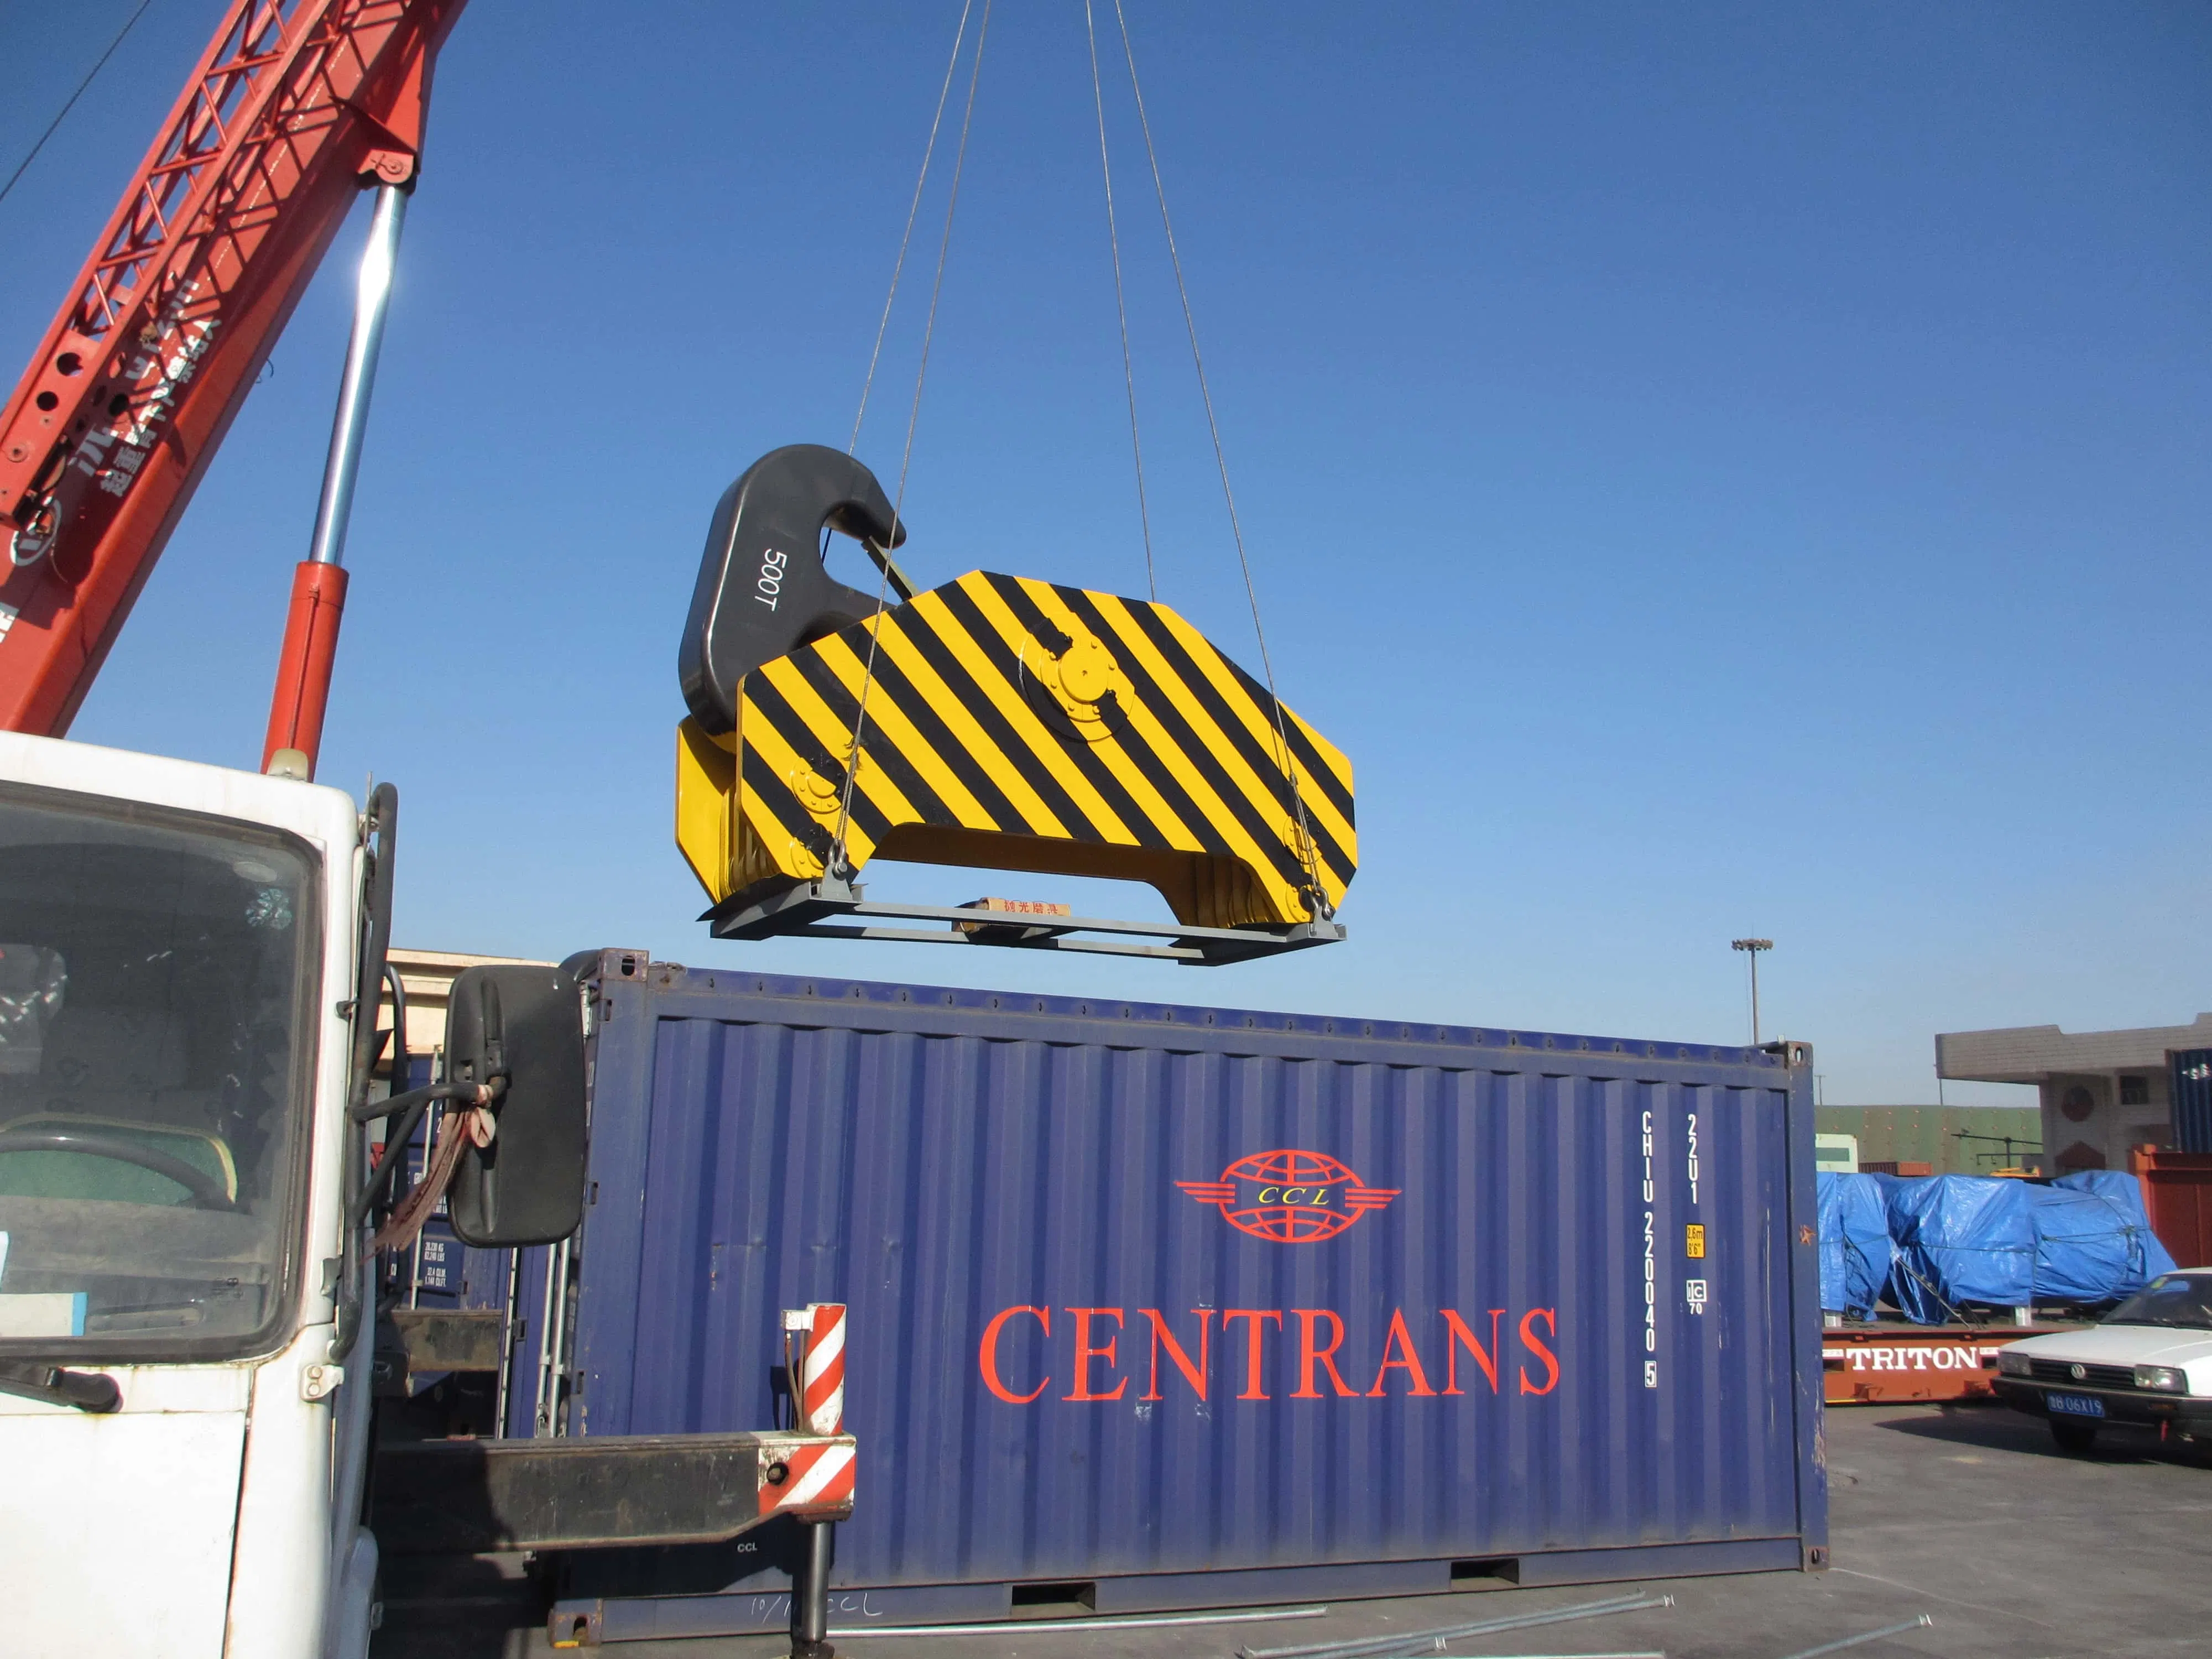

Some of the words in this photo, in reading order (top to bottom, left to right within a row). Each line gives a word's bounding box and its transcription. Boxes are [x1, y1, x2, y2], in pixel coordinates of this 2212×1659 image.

[754, 548, 787, 612] 500T
[1642, 1110, 1654, 1203] CHIU
[1687, 1114, 1699, 1204] 22U1
[1257, 1186, 1331, 1205] CCL
[1643, 1211, 1656, 1352] 220040
[1689, 1302, 1703, 1315] 70
[978, 1305, 1561, 1405] CENTRANS
[1645, 1362, 1656, 1386] 5
[1845, 1346, 1979, 1371] TRITON
[737, 1541, 758, 1553] CCL
